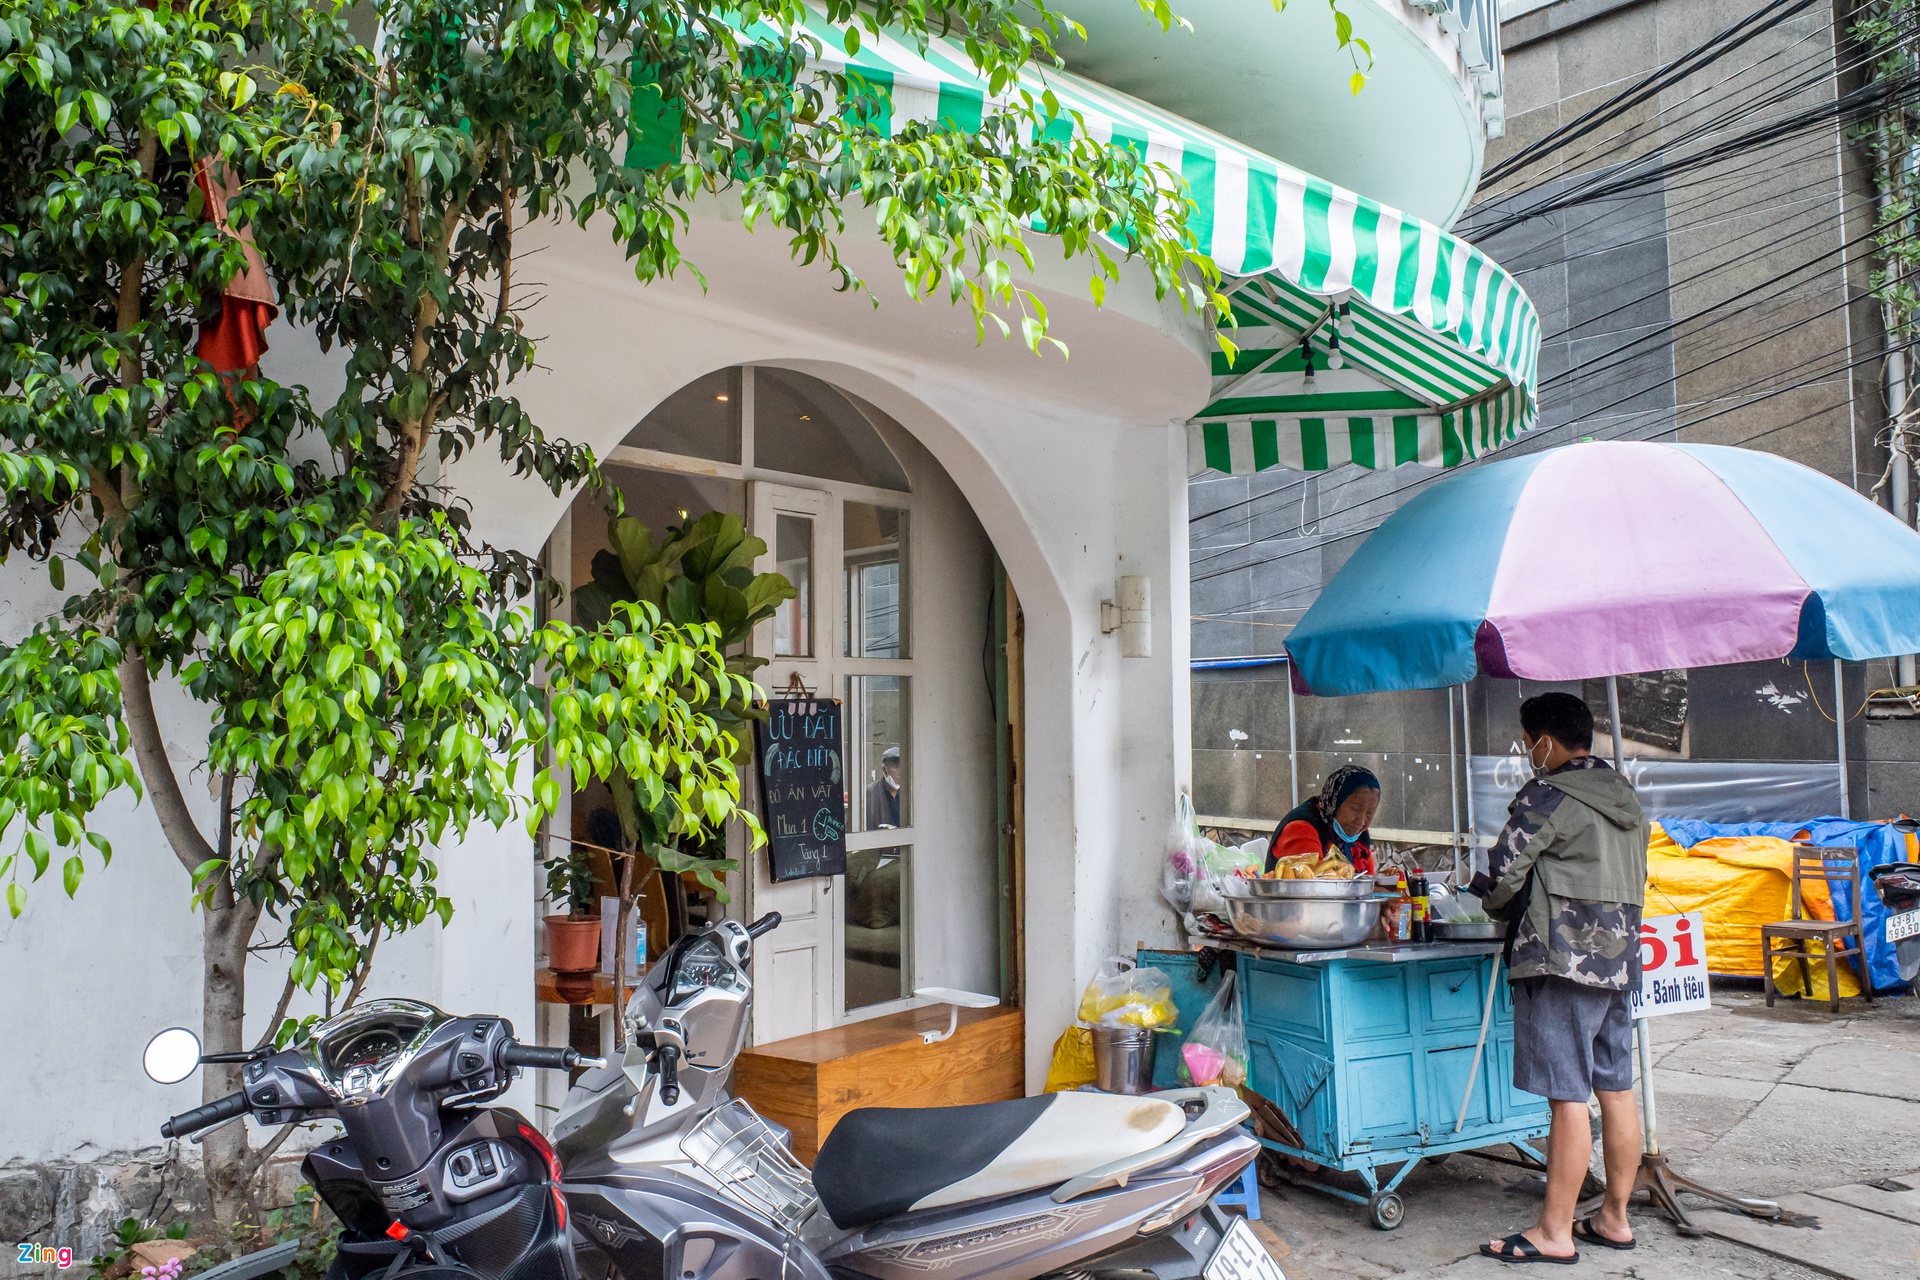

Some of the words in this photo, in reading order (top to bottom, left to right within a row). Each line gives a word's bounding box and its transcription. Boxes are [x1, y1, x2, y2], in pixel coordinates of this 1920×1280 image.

[803, 708, 835, 740] ĐÃI
[787, 783, 805, 800] ĂN
[777, 814, 797, 836] Mua
[800, 818, 808, 833] 1
[822, 844, 828, 858] 1
[1640, 918, 1699, 972] ôi
[1653, 978, 1682, 1005] Bánh
[1683, 976, 1705, 1001] tiêu
[1194, 1227, 1208, 1245] HONDA
